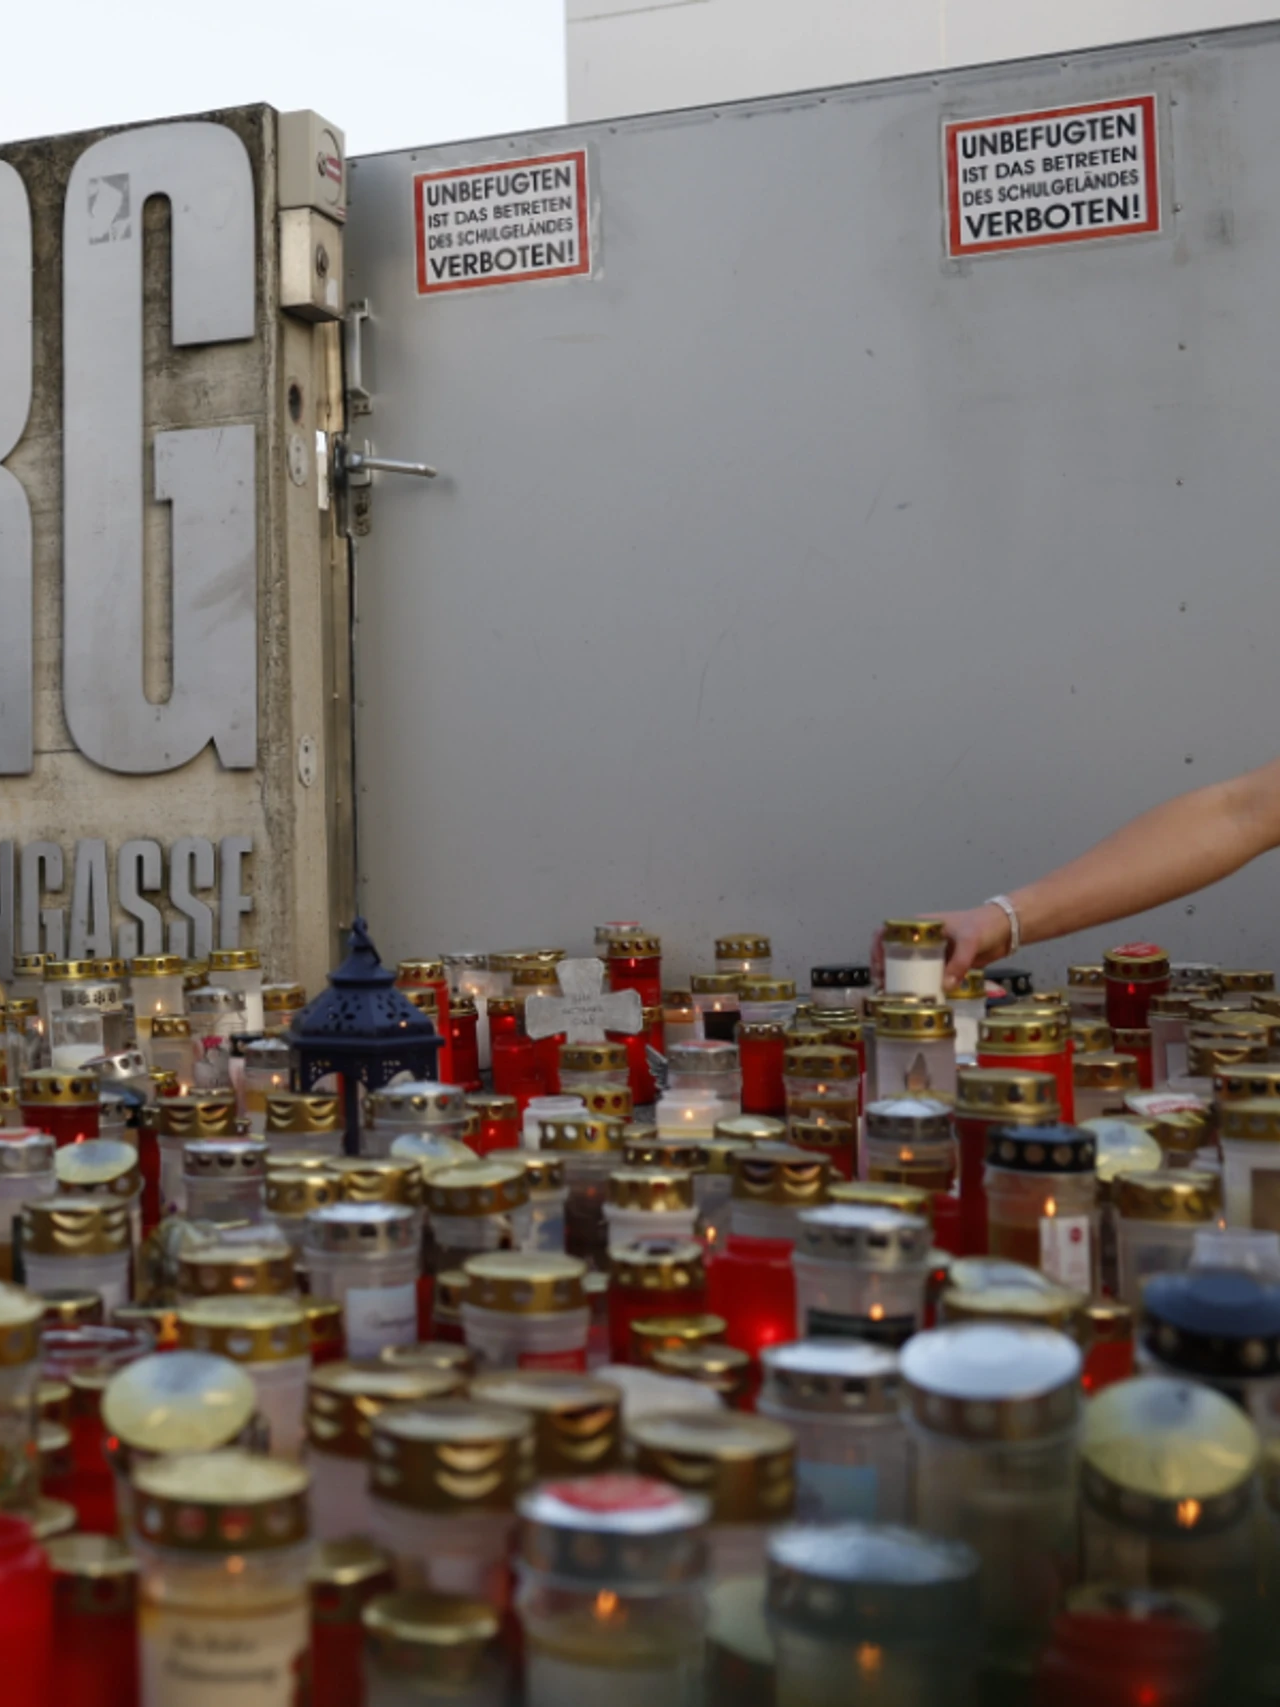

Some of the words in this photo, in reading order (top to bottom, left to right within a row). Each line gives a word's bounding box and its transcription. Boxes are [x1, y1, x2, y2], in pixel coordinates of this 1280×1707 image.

[961, 113, 1136, 159] UNBEFUGTEN
[962, 165, 988, 183] IST
[995, 159, 1035, 179] DAS
[1042, 145, 1137, 172] BETRETEN
[426, 166, 570, 206] UNBEFUGTEN
[962, 188, 993, 207] DES
[998, 169, 1139, 203] SCHULGELÄNDES
[428, 212, 449, 229] IST
[454, 207, 488, 225] DAS
[493, 196, 572, 219] BETRETEN
[965, 194, 1140, 239] VERBOTEN!
[428, 232, 453, 251] DES
[457, 217, 573, 246] SCHULGELÄNDES
[430, 239, 574, 279] VERBOTEN!
